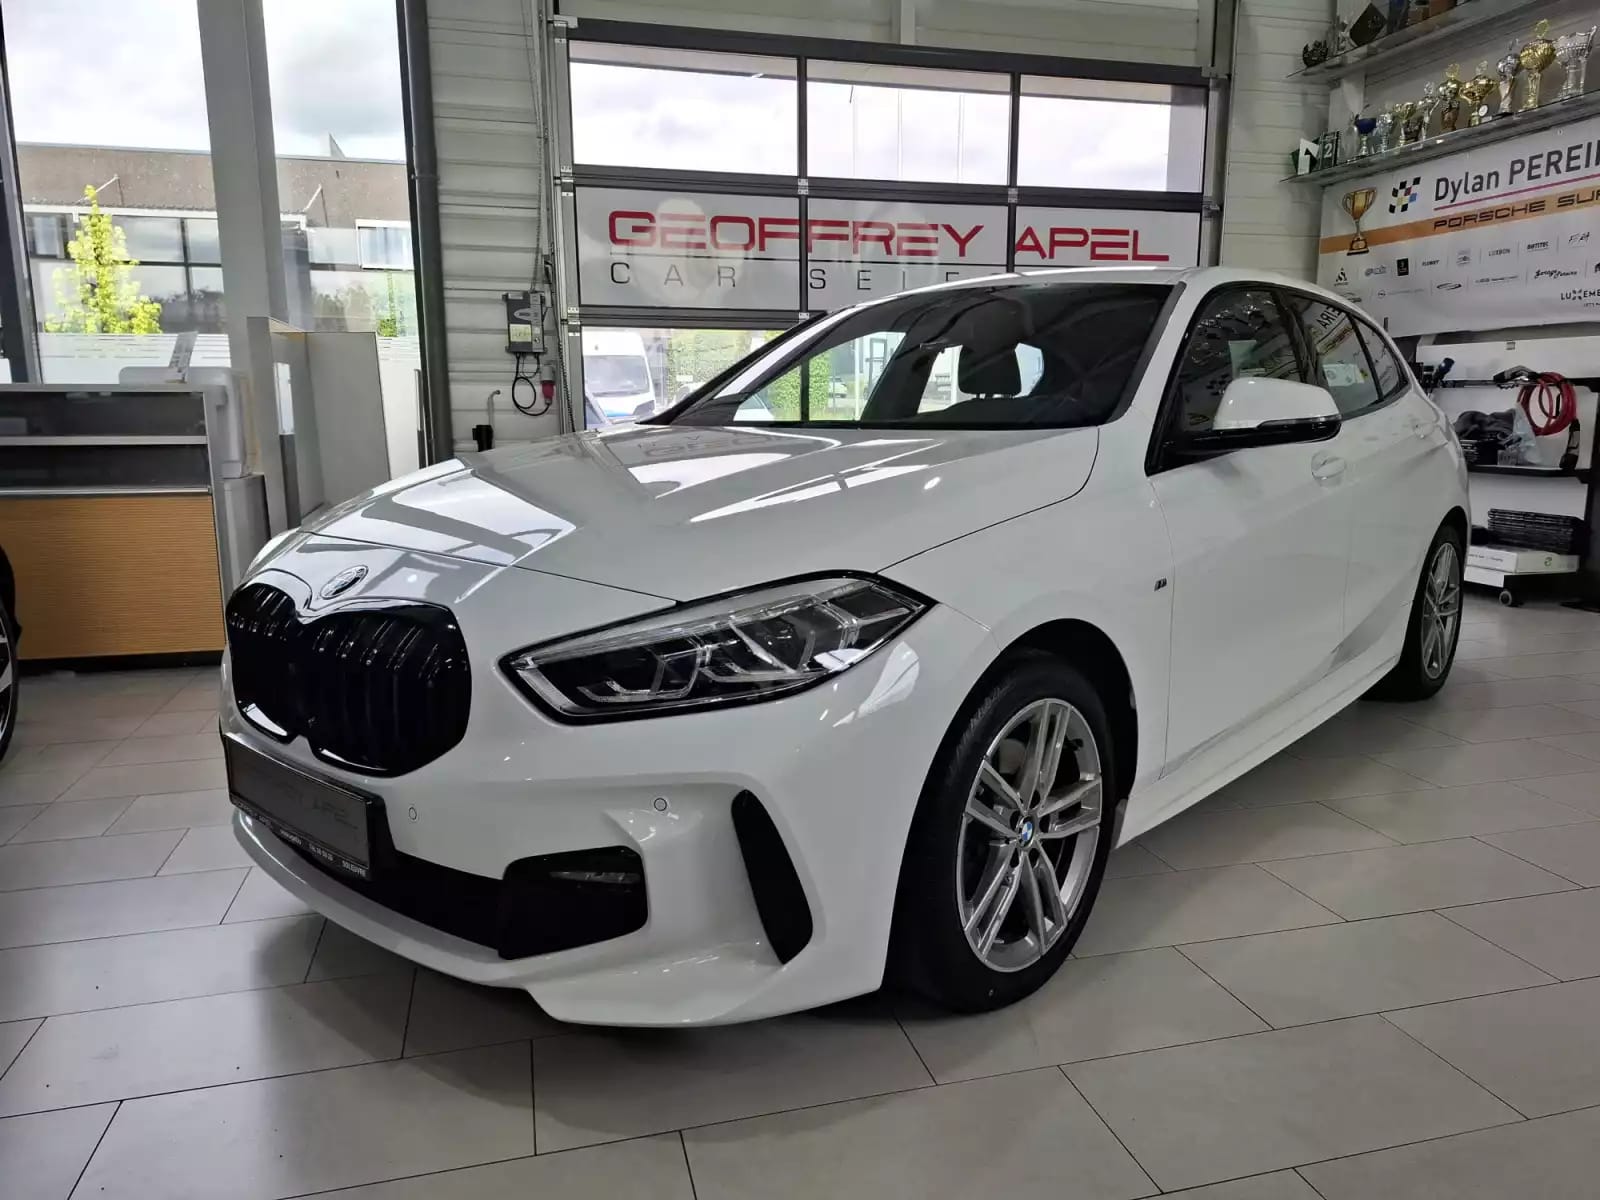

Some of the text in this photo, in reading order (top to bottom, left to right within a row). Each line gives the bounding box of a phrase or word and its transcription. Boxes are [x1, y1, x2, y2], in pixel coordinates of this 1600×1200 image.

[1434, 139, 1600, 203] Dylan PEREI
[608, 210, 1170, 261] GEOFFREY APEL
[1433, 200, 1546, 231] PORSCHE
[610, 261, 736, 288] CAR
